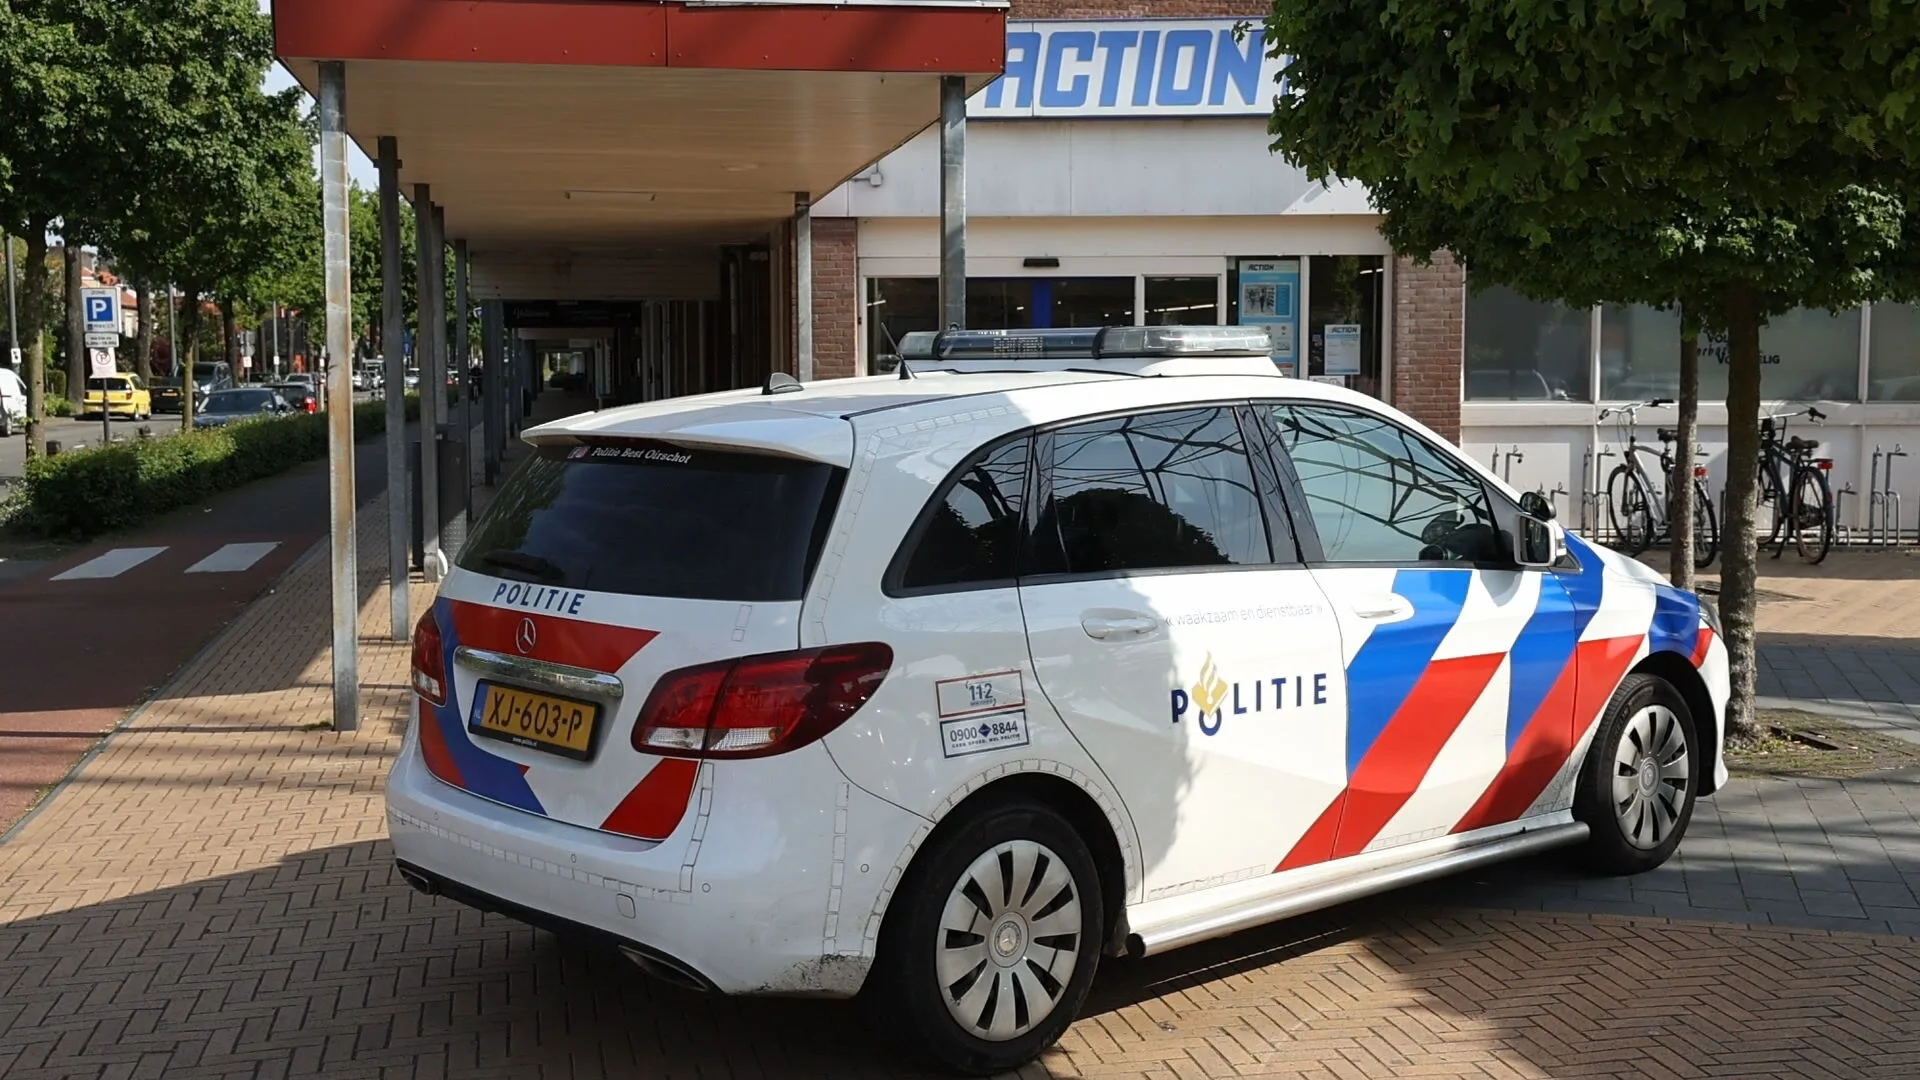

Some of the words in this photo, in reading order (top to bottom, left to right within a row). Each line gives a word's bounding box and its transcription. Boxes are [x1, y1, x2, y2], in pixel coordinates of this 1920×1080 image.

[984, 29, 1265, 108] ACTION
[92, 300, 107, 319] P
[591, 447, 620, 457] Politie
[621, 448, 645, 459] Best
[645, 449, 692, 464] Oirschot
[493, 583, 586, 615] POLITIE
[1177, 610, 1241, 626] waakzaam
[1241, 609, 1256, 621] en
[1256, 603, 1314, 620] dienstbaar
[489, 692, 583, 743] XJ-603-P
[1171, 673, 1327, 736] POLITIE
[949, 726, 978, 742] 0900
[991, 720, 1018, 736] 8844
